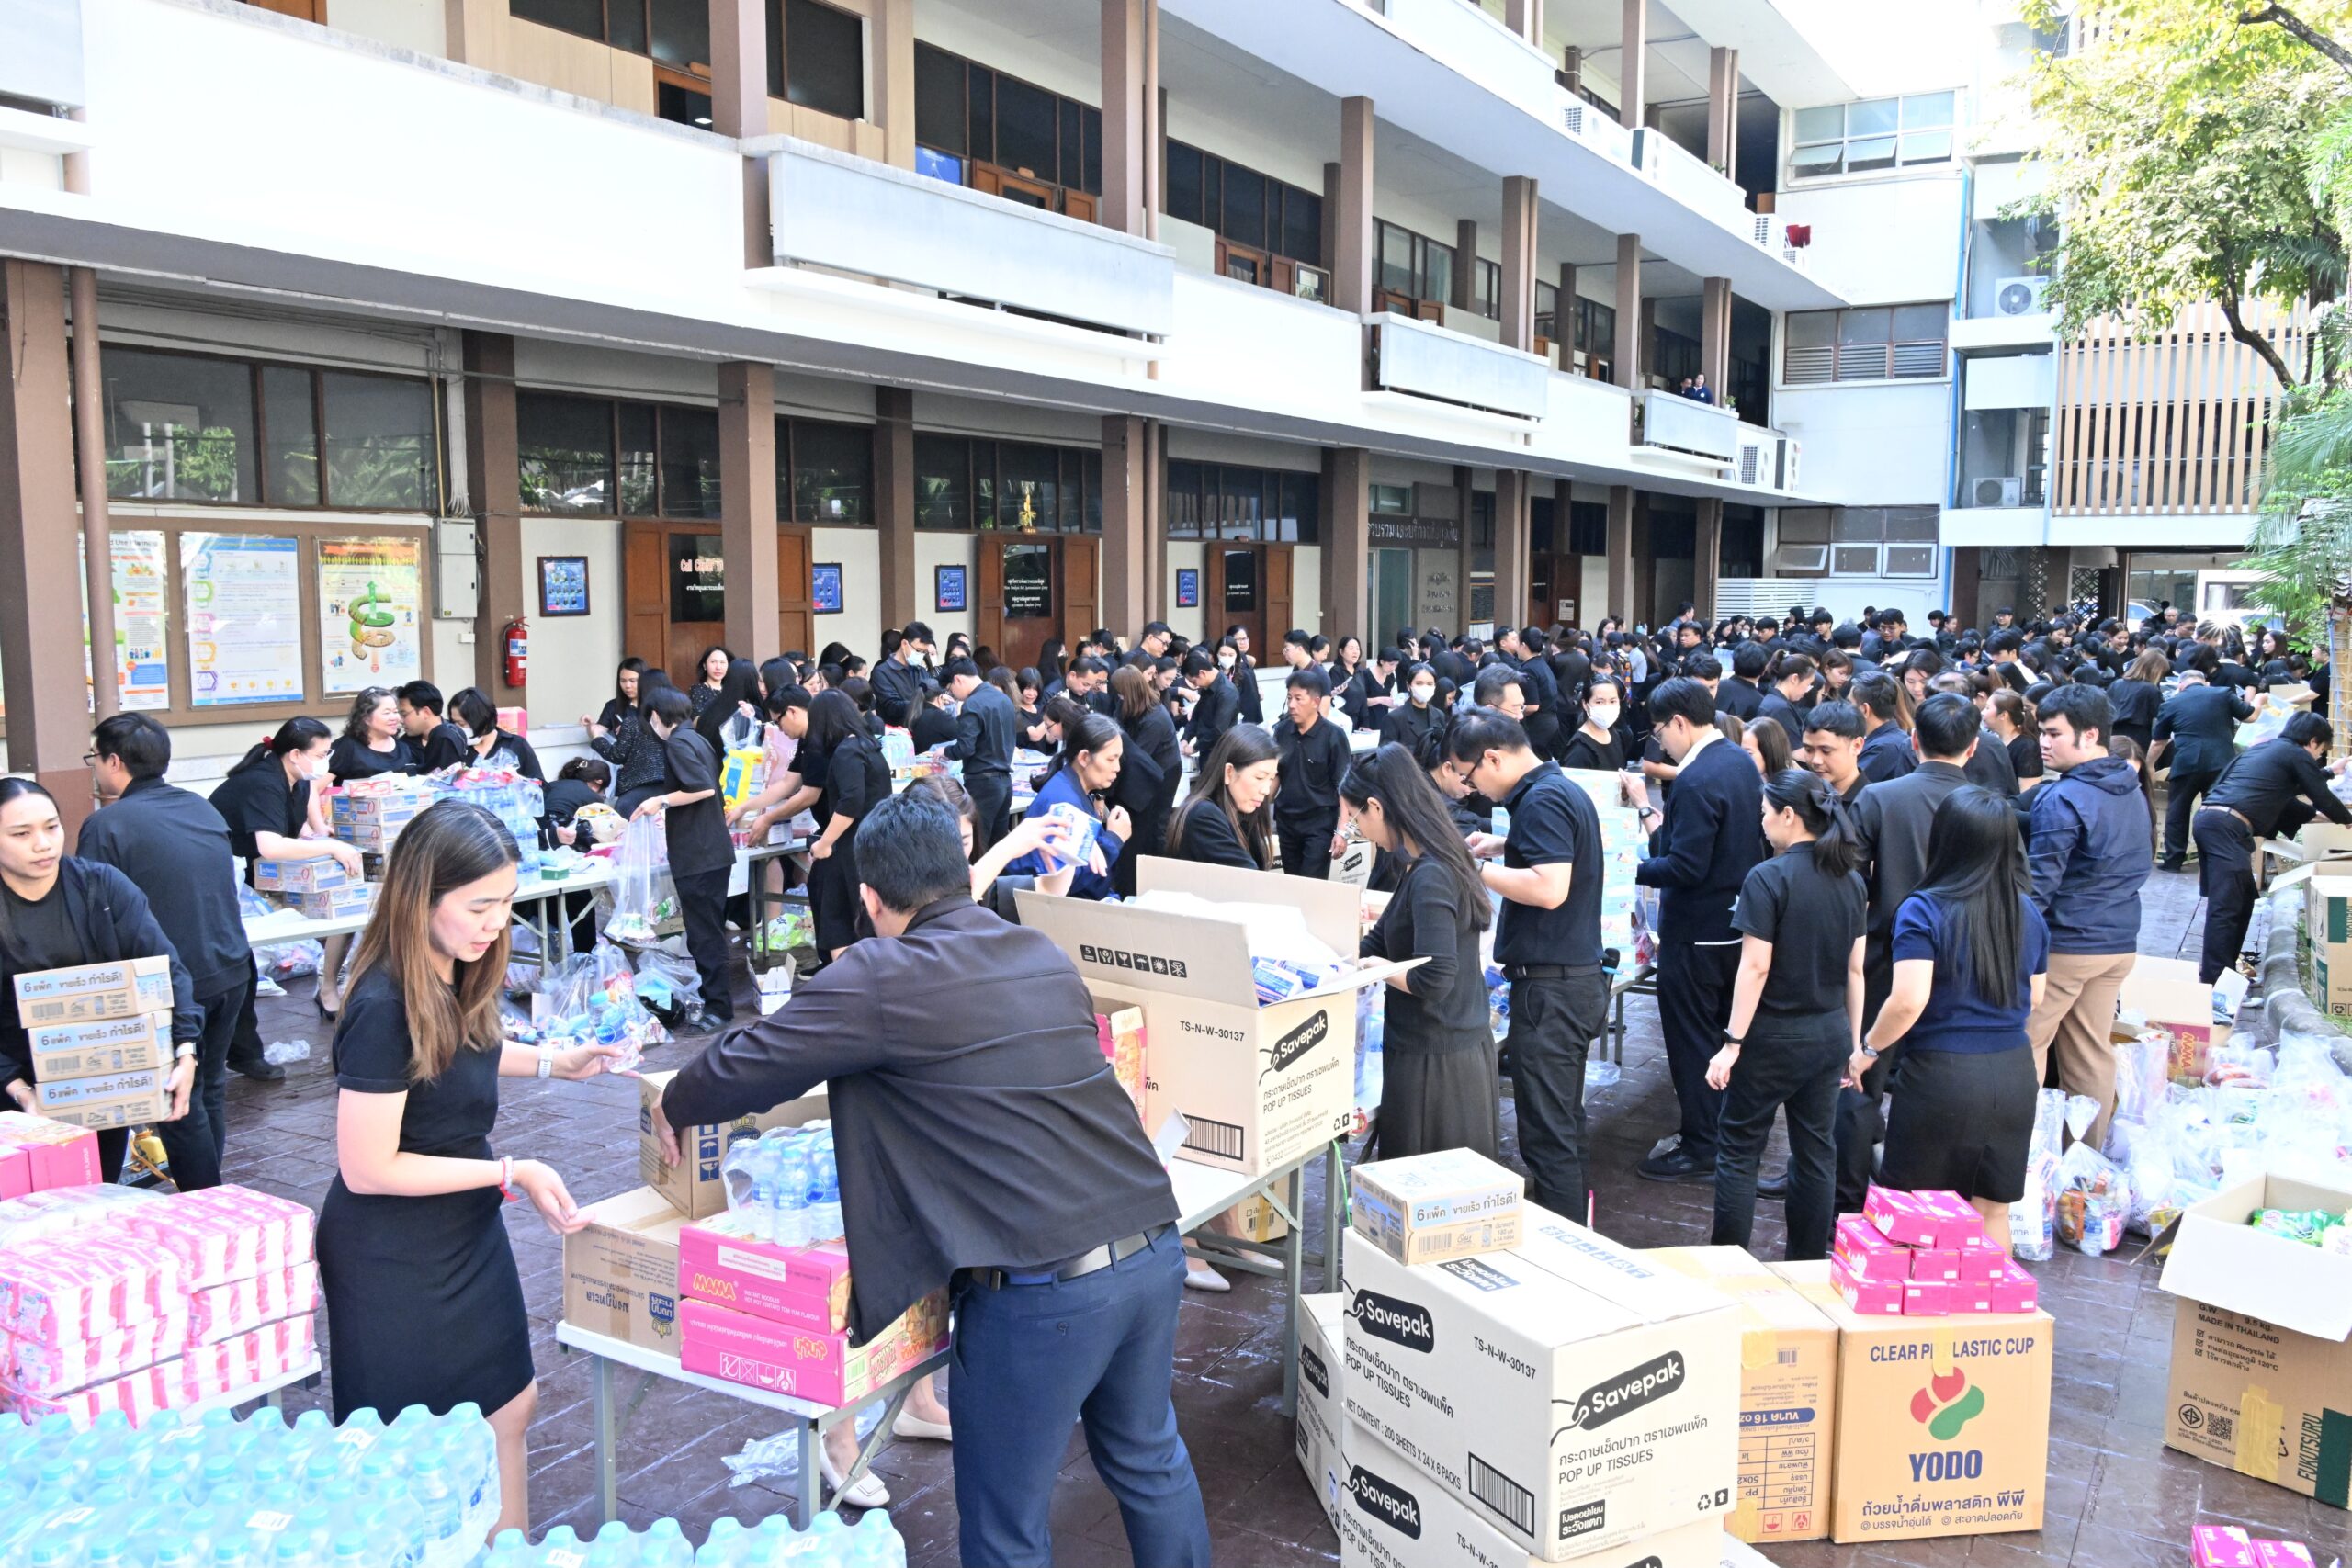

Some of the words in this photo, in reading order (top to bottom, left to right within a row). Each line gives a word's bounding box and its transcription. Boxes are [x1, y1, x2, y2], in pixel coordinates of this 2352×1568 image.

[24, 981, 31, 992] 6
[33, 980, 52, 991] แพ็ค
[89, 971, 123, 985] กำไรดี!
[40, 1035, 49, 1046] 6
[51, 1033, 71, 1043] แพ็ค
[110, 1024, 145, 1038] กำไรดี!
[1180, 1021, 1245, 1042] TS-N-W-30137
[1280, 1015, 1327, 1058] Savepak
[48, 1089, 56, 1099] 6
[58, 1086, 78, 1097] แพ็ค
[117, 1076, 153, 1090] กำไรดี!
[1263, 1101, 1276, 1114] POP
[1277, 1096, 1286, 1108] UP
[1287, 1084, 1312, 1102] TISSUES
[1417, 1209, 1424, 1221] 6
[1427, 1205, 1446, 1220] แพ็ค
[1453, 1201, 1481, 1214] ขายเร็ว
[1483, 1192, 1517, 1209] กำไรดี!
[694, 1273, 736, 1301] MAMA
[1366, 1298, 1430, 1339] Savepak
[2199, 1314, 2222, 1326] MADE
[2224, 1321, 2233, 1330] IN
[2236, 1325, 2279, 1344] THAILAND
[794, 1337, 827, 1359] มาม่า
[1346, 1337, 1401, 1382] กระดาษเช็ดปาก
[1474, 1336, 1536, 1380] TS-N-W-30137
[1871, 1344, 1917, 1362] CLEAR
[1948, 1339, 2002, 1358] LASTIC
[2006, 1337, 2034, 1355] CUP
[1346, 1353, 1362, 1374] POP
[1363, 1366, 1374, 1382] UP
[1376, 1374, 1411, 1408] TISSUES
[1592, 1359, 1681, 1413] Savepak
[1754, 1414, 1767, 1423] 16
[1771, 1412, 1799, 1422] ขนาด
[1346, 1397, 1355, 1415] NET
[1357, 1405, 1380, 1432] CONTENT
[1384, 1425, 1395, 1442] 200
[1396, 1433, 1417, 1457] SHEETS
[1422, 1453, 1430, 1467] 24
[1436, 1462, 1442, 1474] 6
[1442, 1466, 1462, 1491] PACKS
[1559, 1435, 1640, 1467] กระดาษเช็ดปาก
[2297, 1412, 2323, 1483] FUKUTSURU
[1559, 1468, 1583, 1484] POP
[1587, 1462, 1602, 1477] UP
[1607, 1449, 1653, 1472] TISSUES
[1908, 1450, 1983, 1483] YODO
[1360, 1475, 1419, 1527] Savepak
[1746, 1488, 1758, 1496] PP
[1862, 1493, 1992, 1516] ถ้วยน้ำดื่มพลาสติก
[1997, 1489, 2025, 1507] พีพี
[1562, 1505, 1604, 1524] โปรดอย่าโยน
[1562, 1516, 1602, 1535] ระวังแตก
[1873, 1514, 1931, 1532] บรรจุน้ำอุ่นได้
[1955, 1511, 2023, 1525] สะอาดปลอดภัย
[1342, 1508, 1391, 1562] กระดาษเช็ดปาก
[1342, 1526, 1356, 1545] POP
[1357, 1540, 1367, 1556] UP
